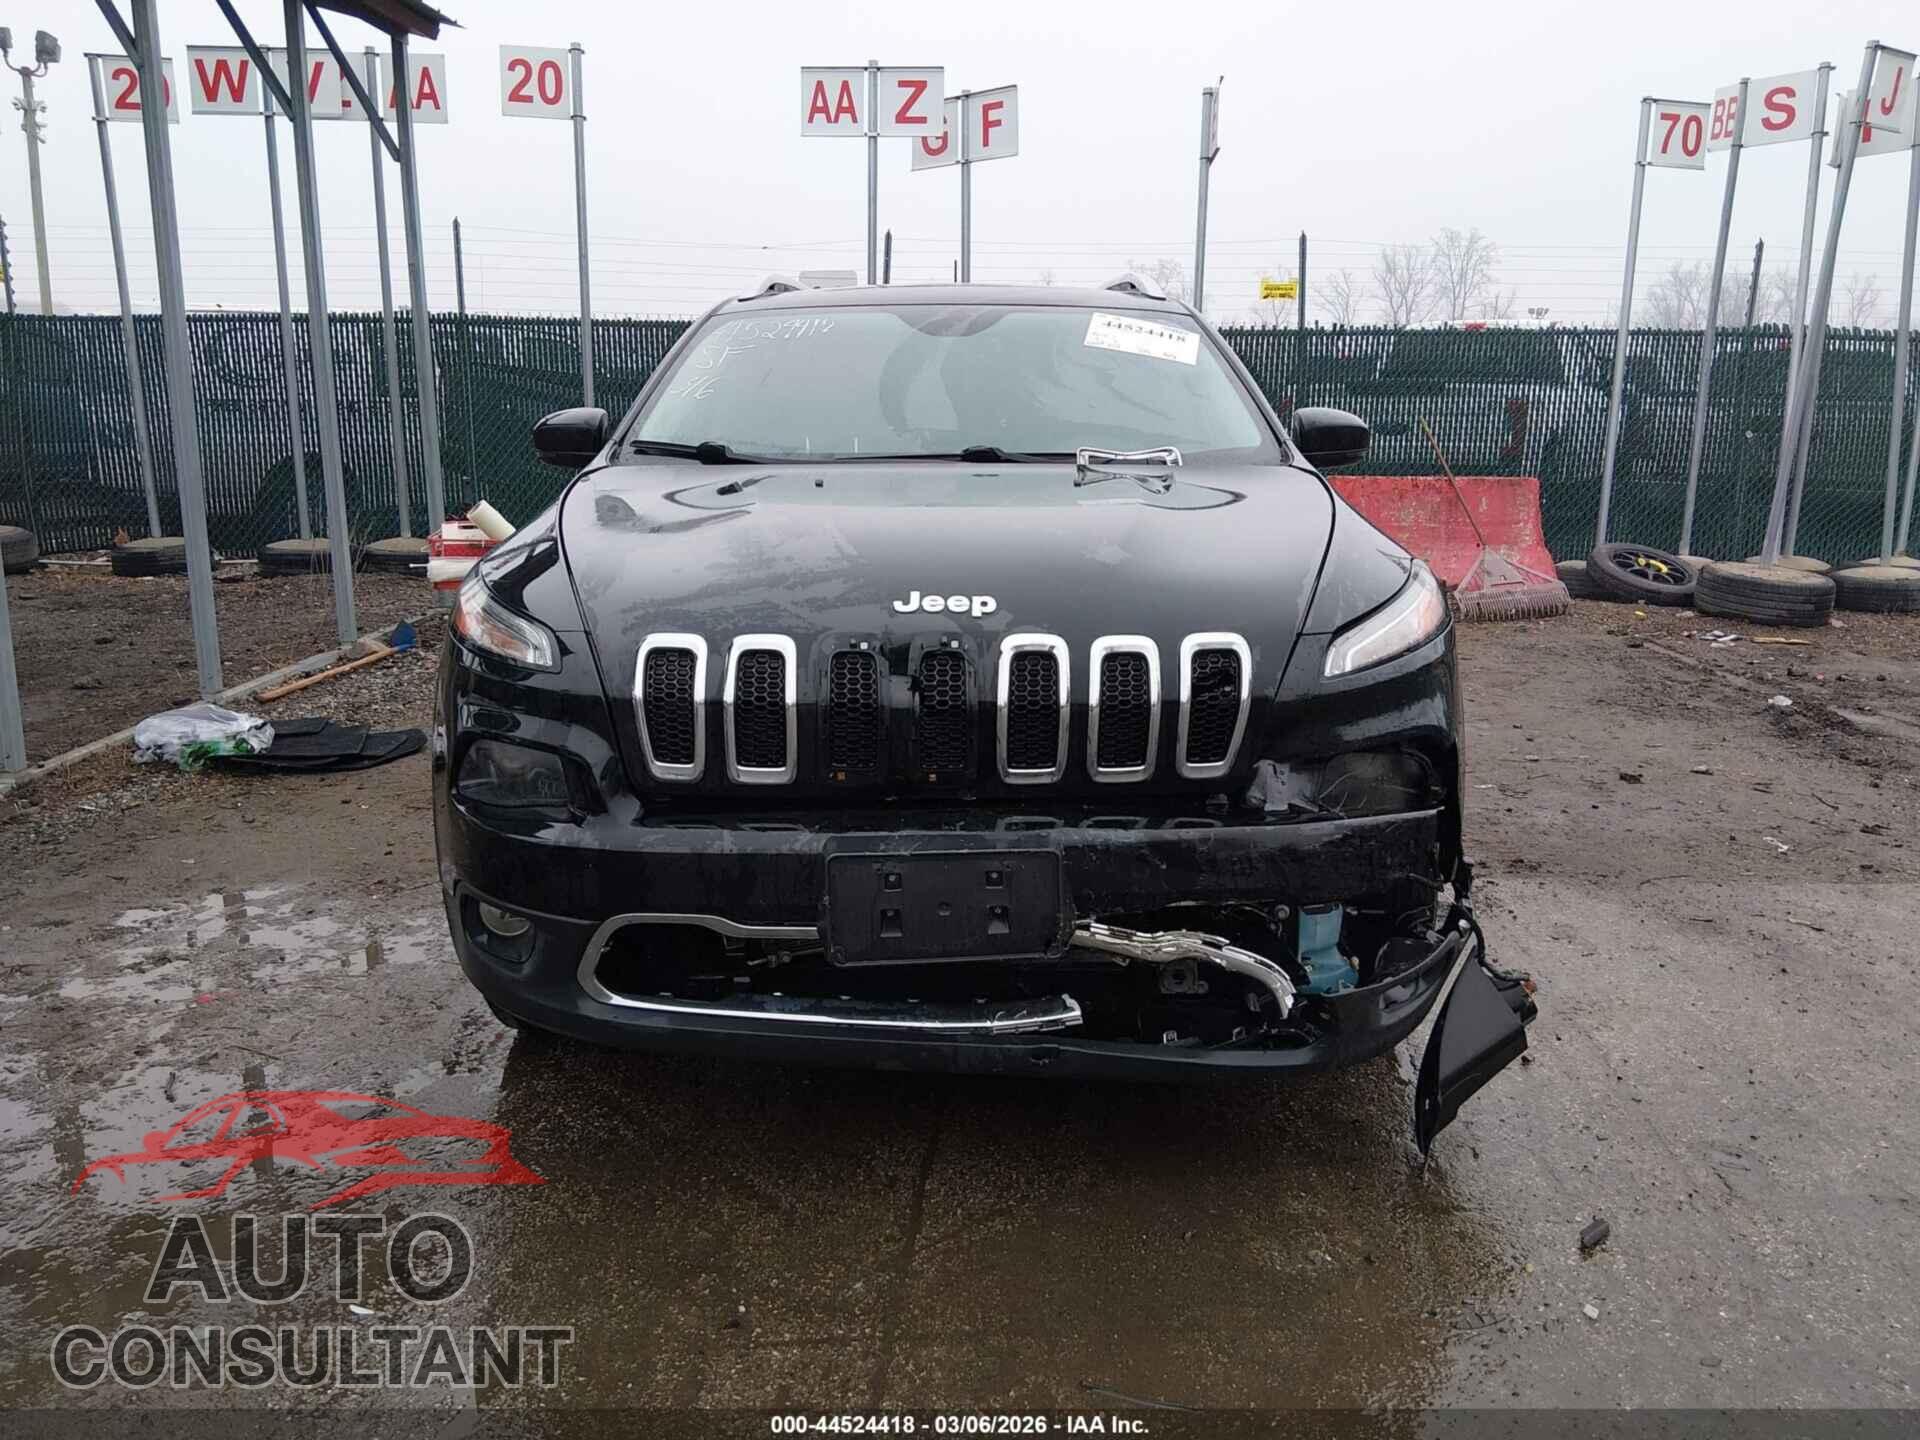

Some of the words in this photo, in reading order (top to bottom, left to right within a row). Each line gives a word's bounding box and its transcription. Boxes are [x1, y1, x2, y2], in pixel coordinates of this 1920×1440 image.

[194, 58, 249, 103] W
[507, 57, 564, 105] 20
[807, 80, 858, 123] AA
[895, 80, 928, 124] Z
[1880, 66, 1903, 116] J
[982, 100, 1004, 146] F
[1761, 86, 1797, 132] S
[1660, 112, 1703, 157] 70
[892, 590, 997, 617] Jeep
